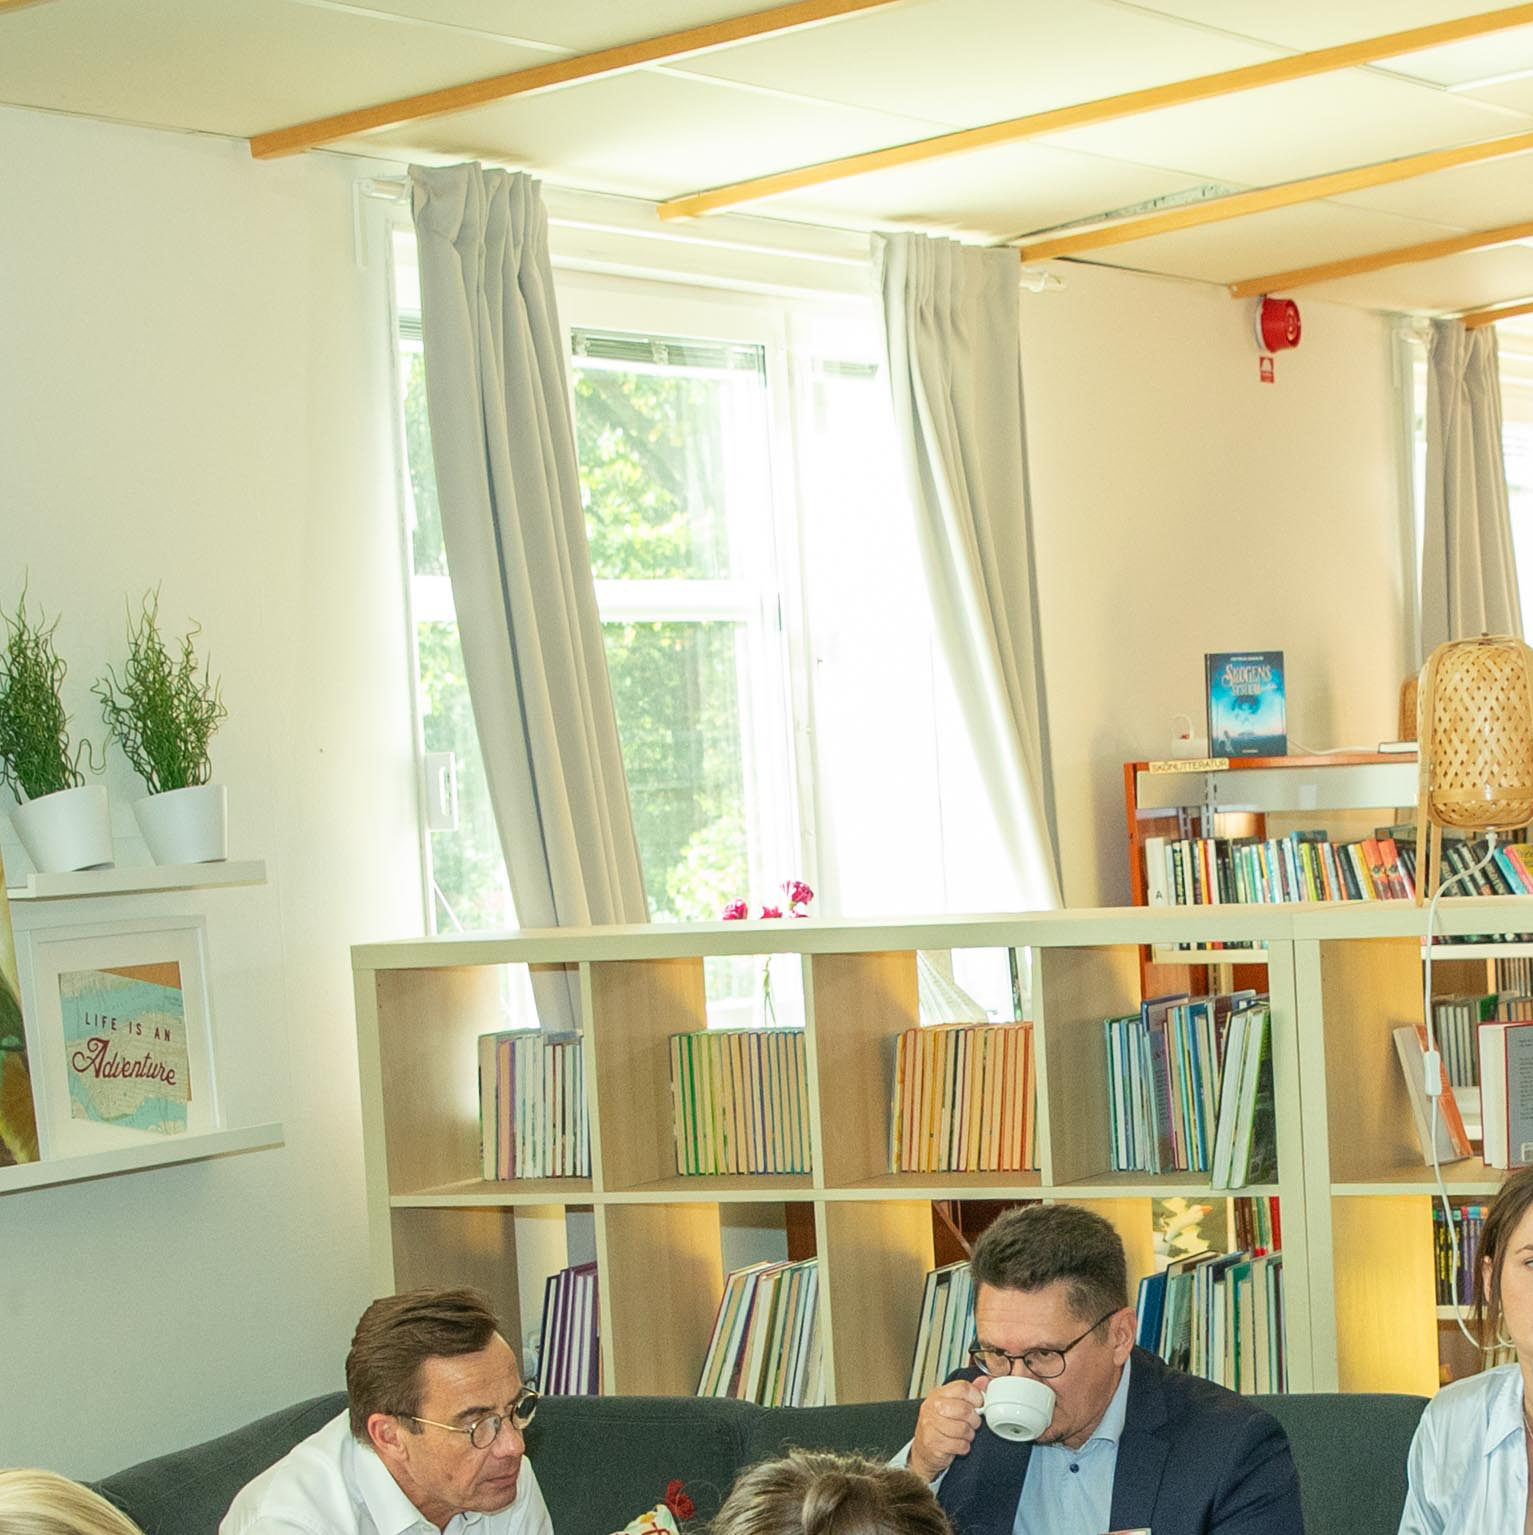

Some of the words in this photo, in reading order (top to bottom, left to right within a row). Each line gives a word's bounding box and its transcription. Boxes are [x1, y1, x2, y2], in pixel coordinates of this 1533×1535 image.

[85, 1012, 117, 1031] LIFE
[129, 1021, 142, 1036] IS
[154, 1027, 171, 1042] AN
[72, 1037, 177, 1086] Adventure
